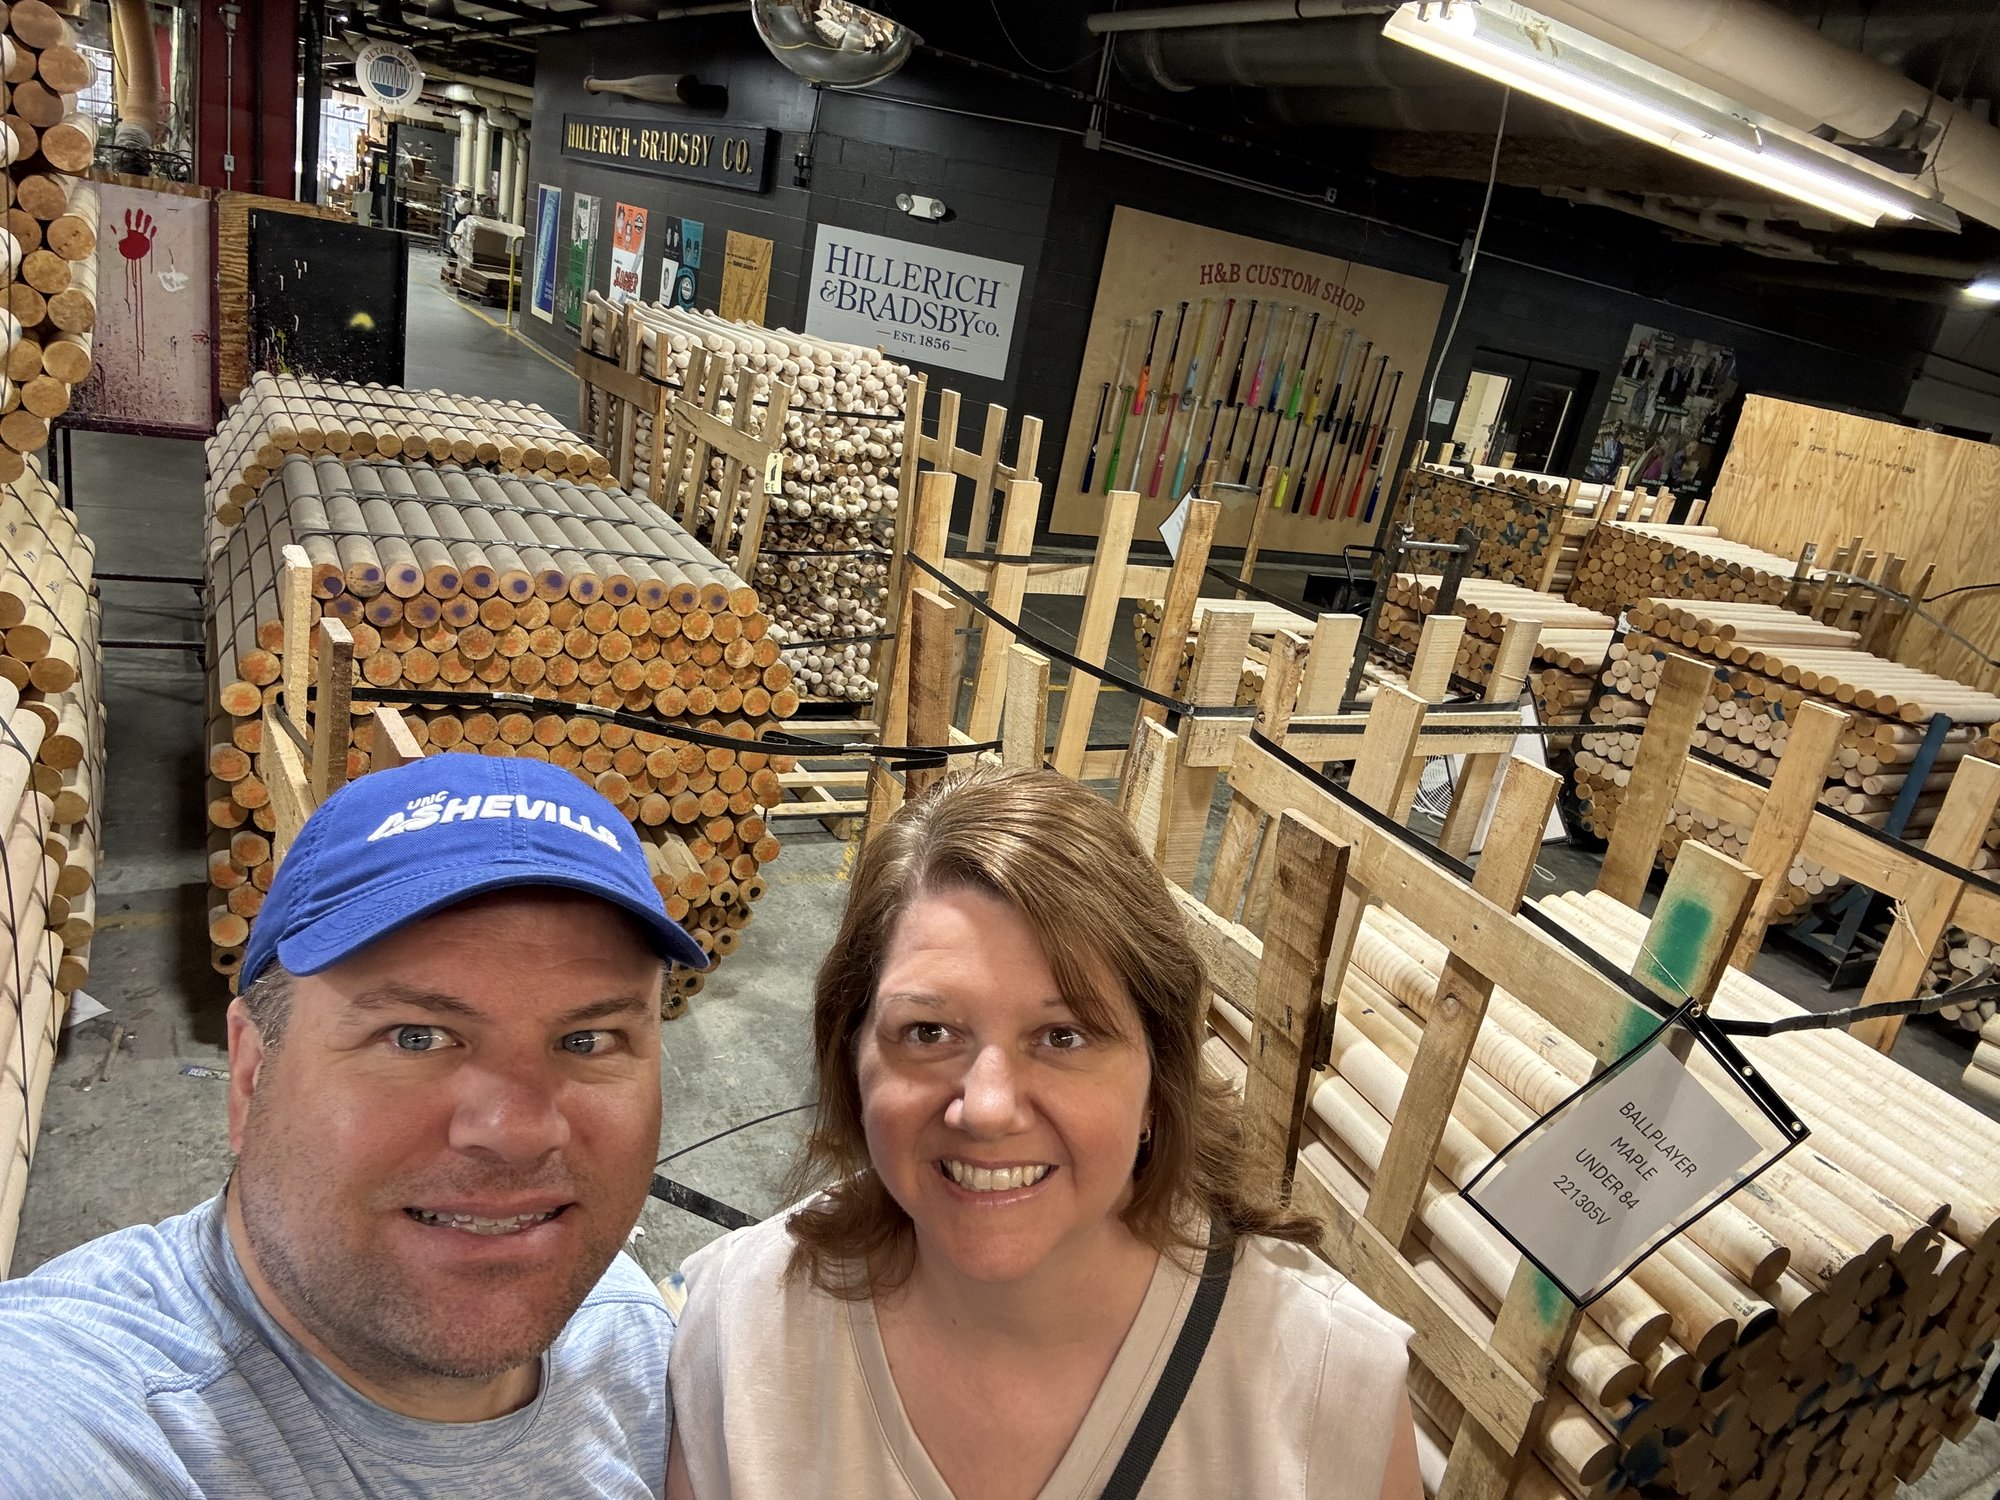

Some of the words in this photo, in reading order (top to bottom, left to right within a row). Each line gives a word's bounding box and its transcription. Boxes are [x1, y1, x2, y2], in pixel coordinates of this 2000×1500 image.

[364, 46, 394, 62] RETAIL
[397, 51, 417, 73] BATS
[640, 130, 715, 167] BRADSBY
[722, 137, 753, 173] CO.
[825, 243, 1001, 309] HILLERICH
[1200, 263, 1241, 285] H&B
[1246, 264, 1321, 297] CUSTOM
[1321, 282, 1366, 317] SHOP
[893, 330, 916, 345] EST.
[919, 335, 951, 351] 1856
[367, 795, 622, 852] ASHEVILLE
[406, 791, 449, 810] UNC
[1609, 1136, 1659, 1182] MAPLE
[1619, 1101, 1698, 1178] BALLPLAYER
[1552, 1174, 1612, 1226] 221305V
[1575, 1148, 1624, 1195] UNDER
[1618, 1190, 1640, 1210] 84
